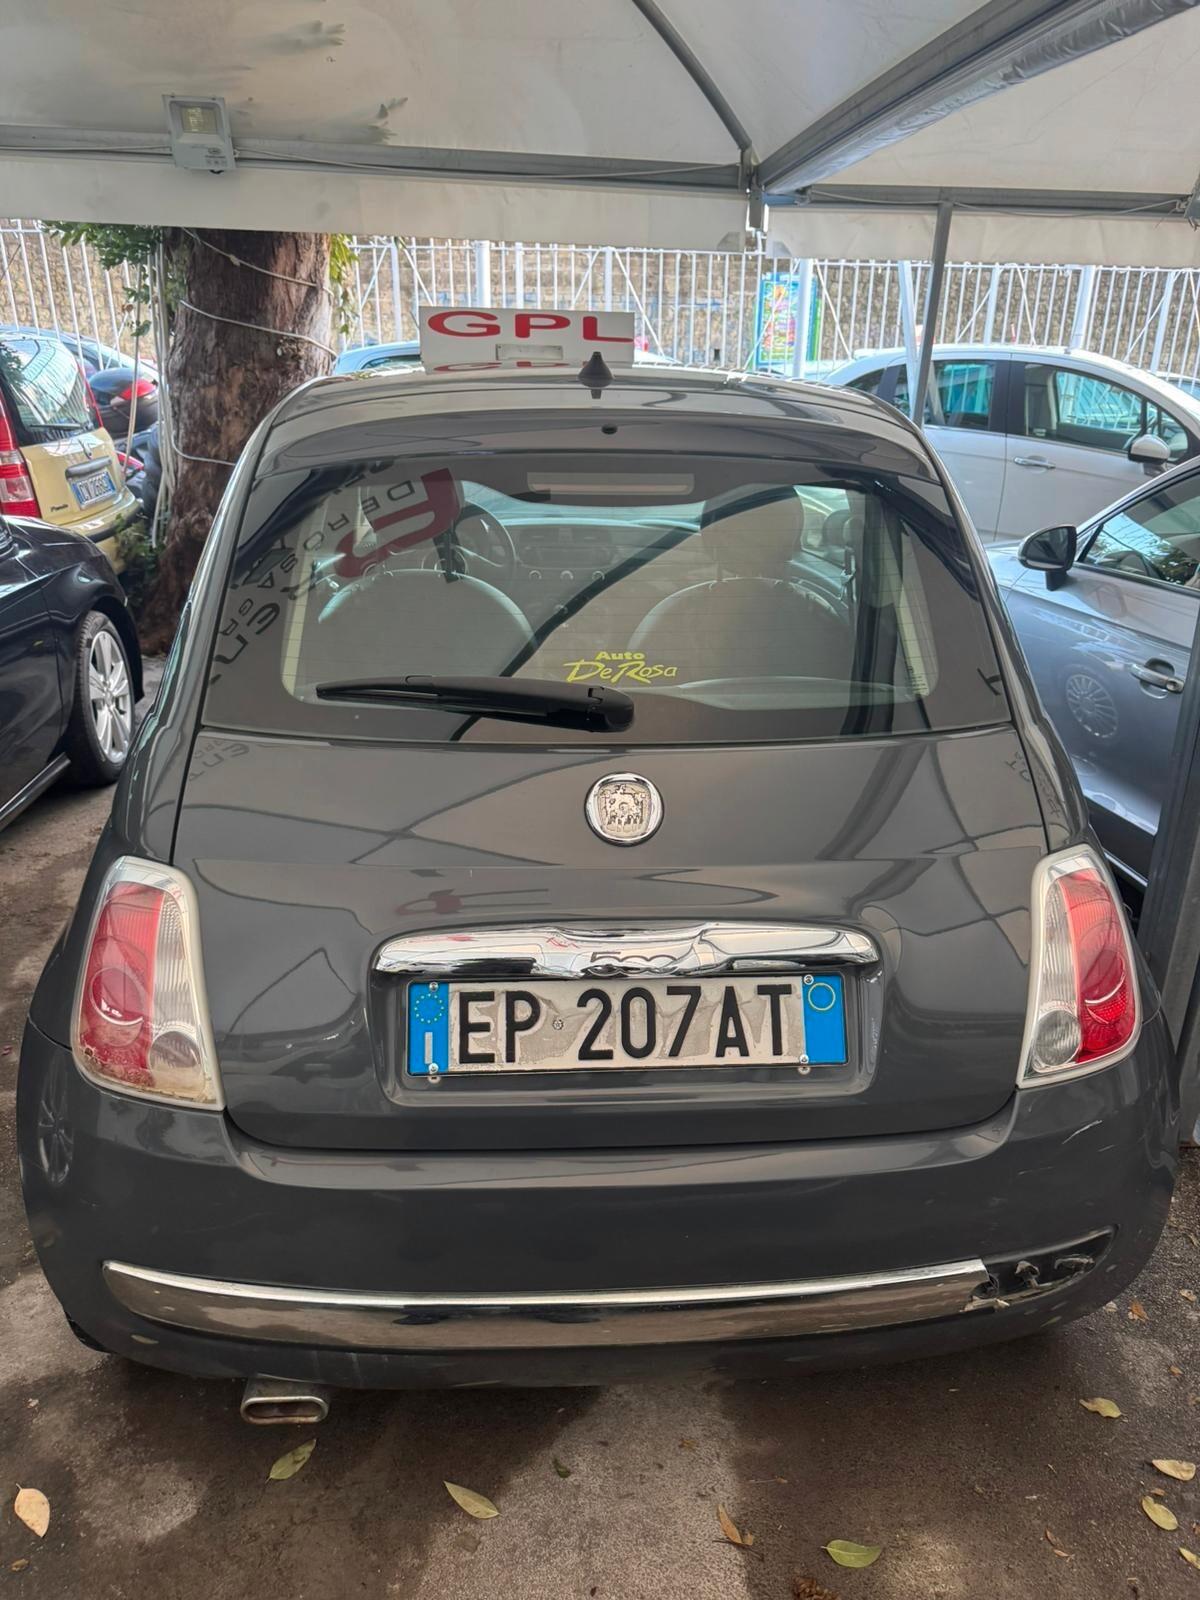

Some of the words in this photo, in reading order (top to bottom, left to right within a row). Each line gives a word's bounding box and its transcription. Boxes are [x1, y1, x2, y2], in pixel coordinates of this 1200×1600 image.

[427, 310, 634, 343] GPL
[594, 650, 646, 661] Auto
[458, 990, 541, 1065] EP
